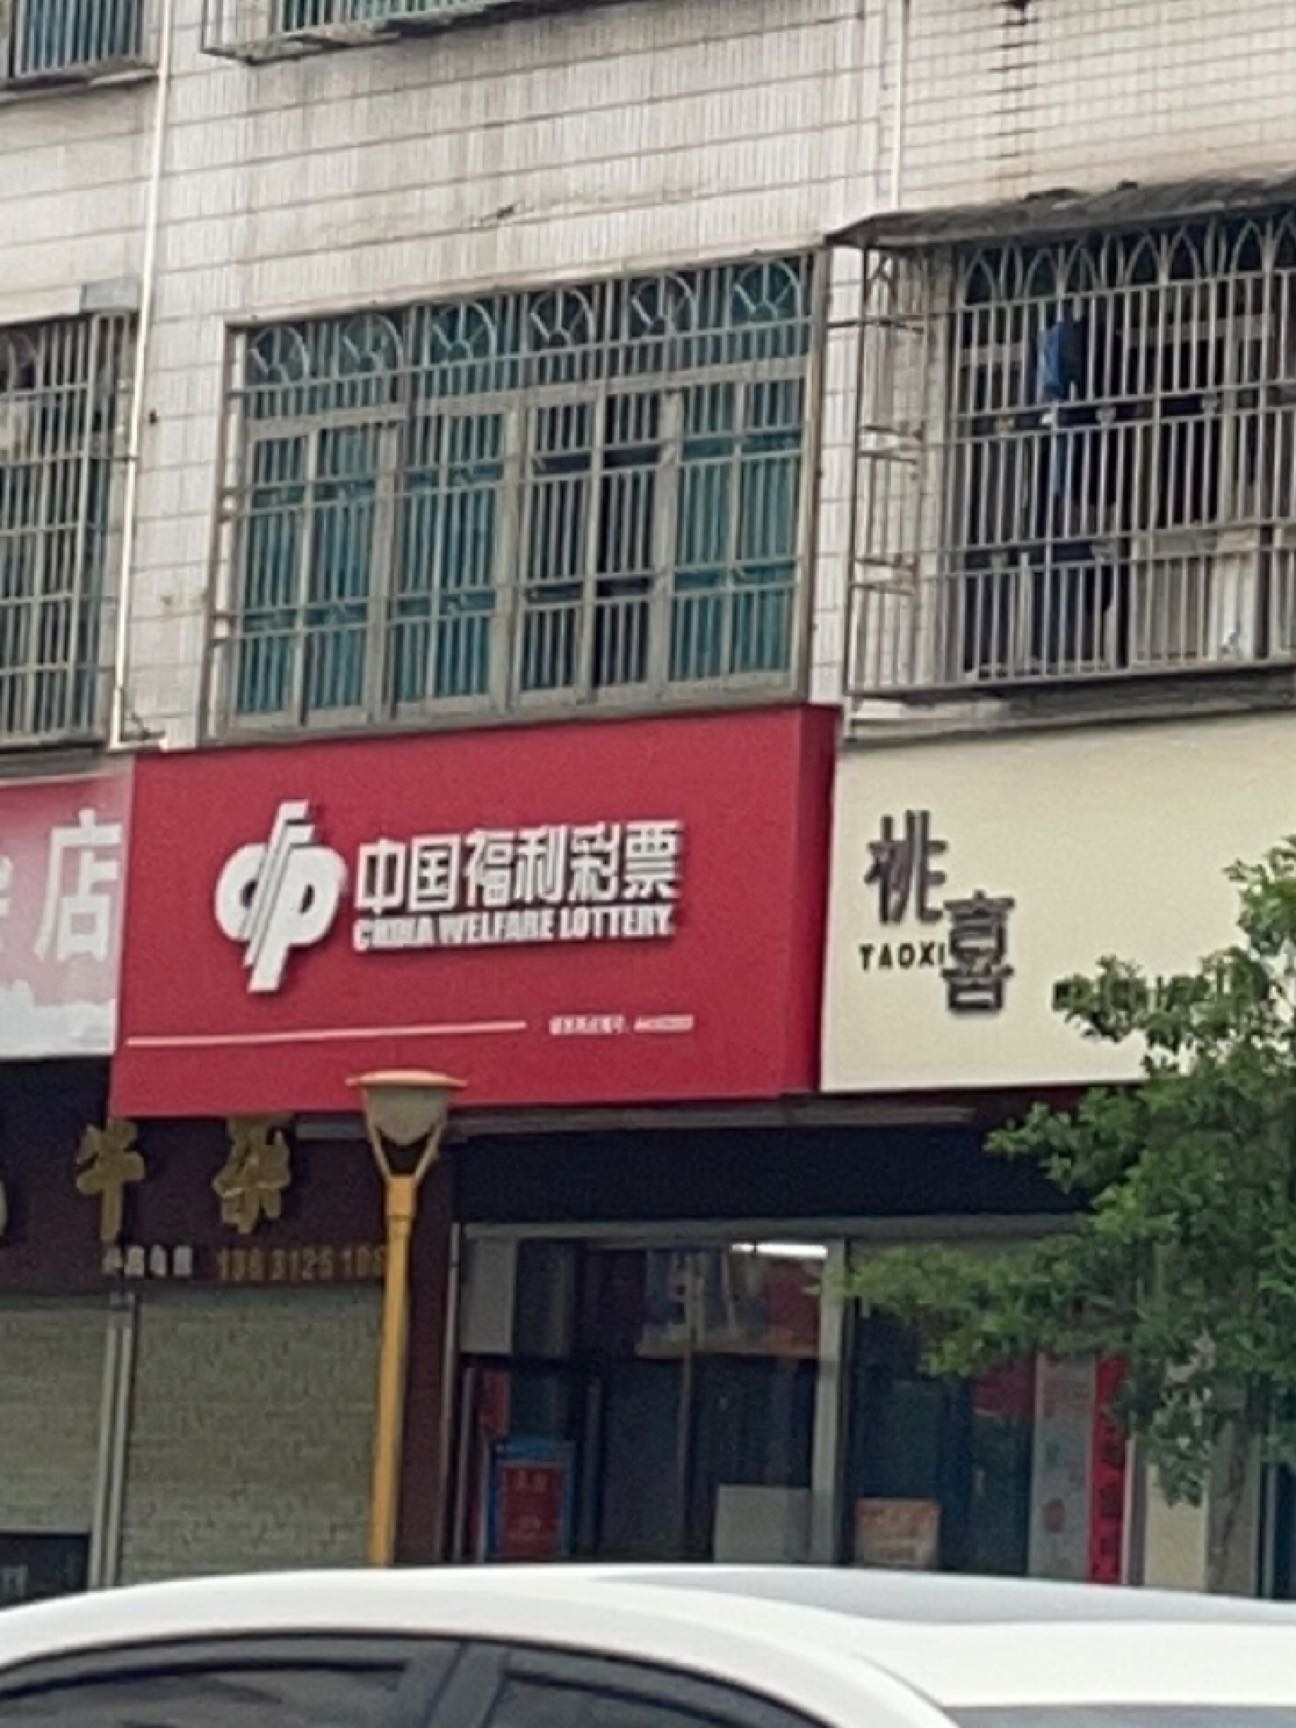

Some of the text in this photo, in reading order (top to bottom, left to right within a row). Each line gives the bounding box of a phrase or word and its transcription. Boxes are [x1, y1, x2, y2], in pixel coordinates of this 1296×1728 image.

[354, 820, 682, 914] 中国福利彩票
[353, 902, 676, 951] CHINA WELFARE LOTTERY
[858, 941, 946, 970] TAOXI
